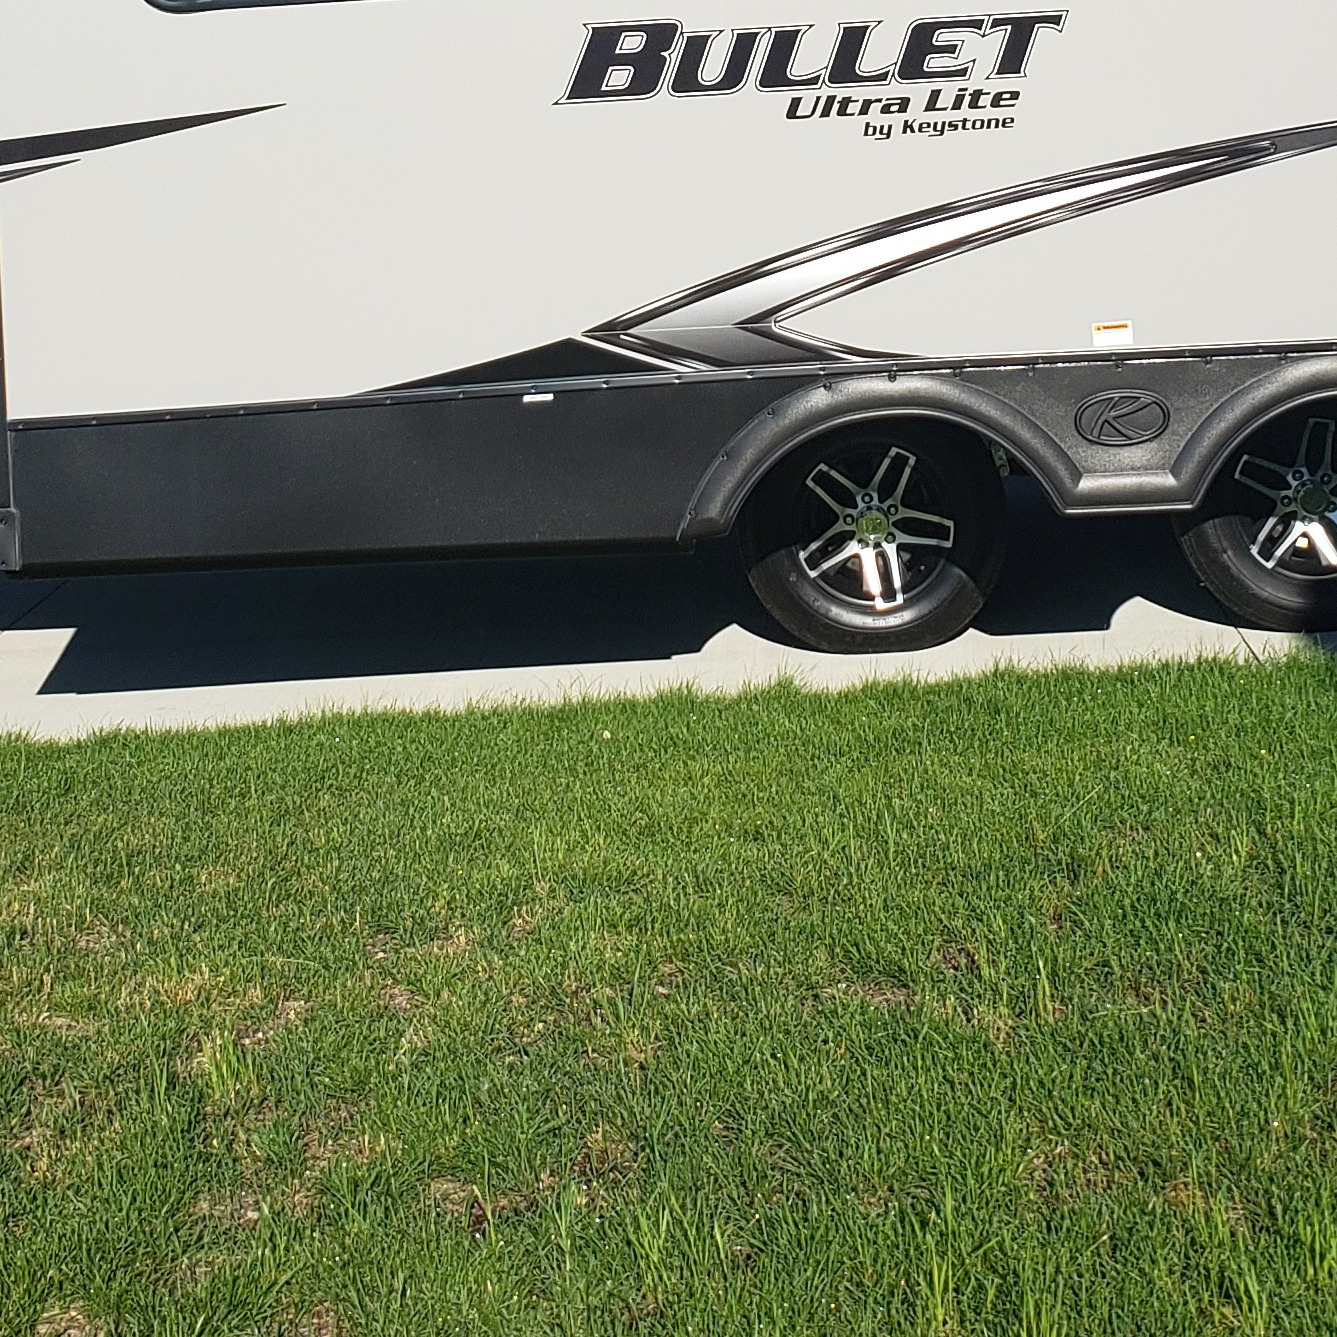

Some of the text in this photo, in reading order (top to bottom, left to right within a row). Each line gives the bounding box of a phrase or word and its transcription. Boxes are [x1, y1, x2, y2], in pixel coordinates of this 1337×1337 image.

[552, 10, 1069, 105] BULLET
[785, 87, 1021, 120] Ultra Lite
[863, 116, 1015, 141] by Keystone
